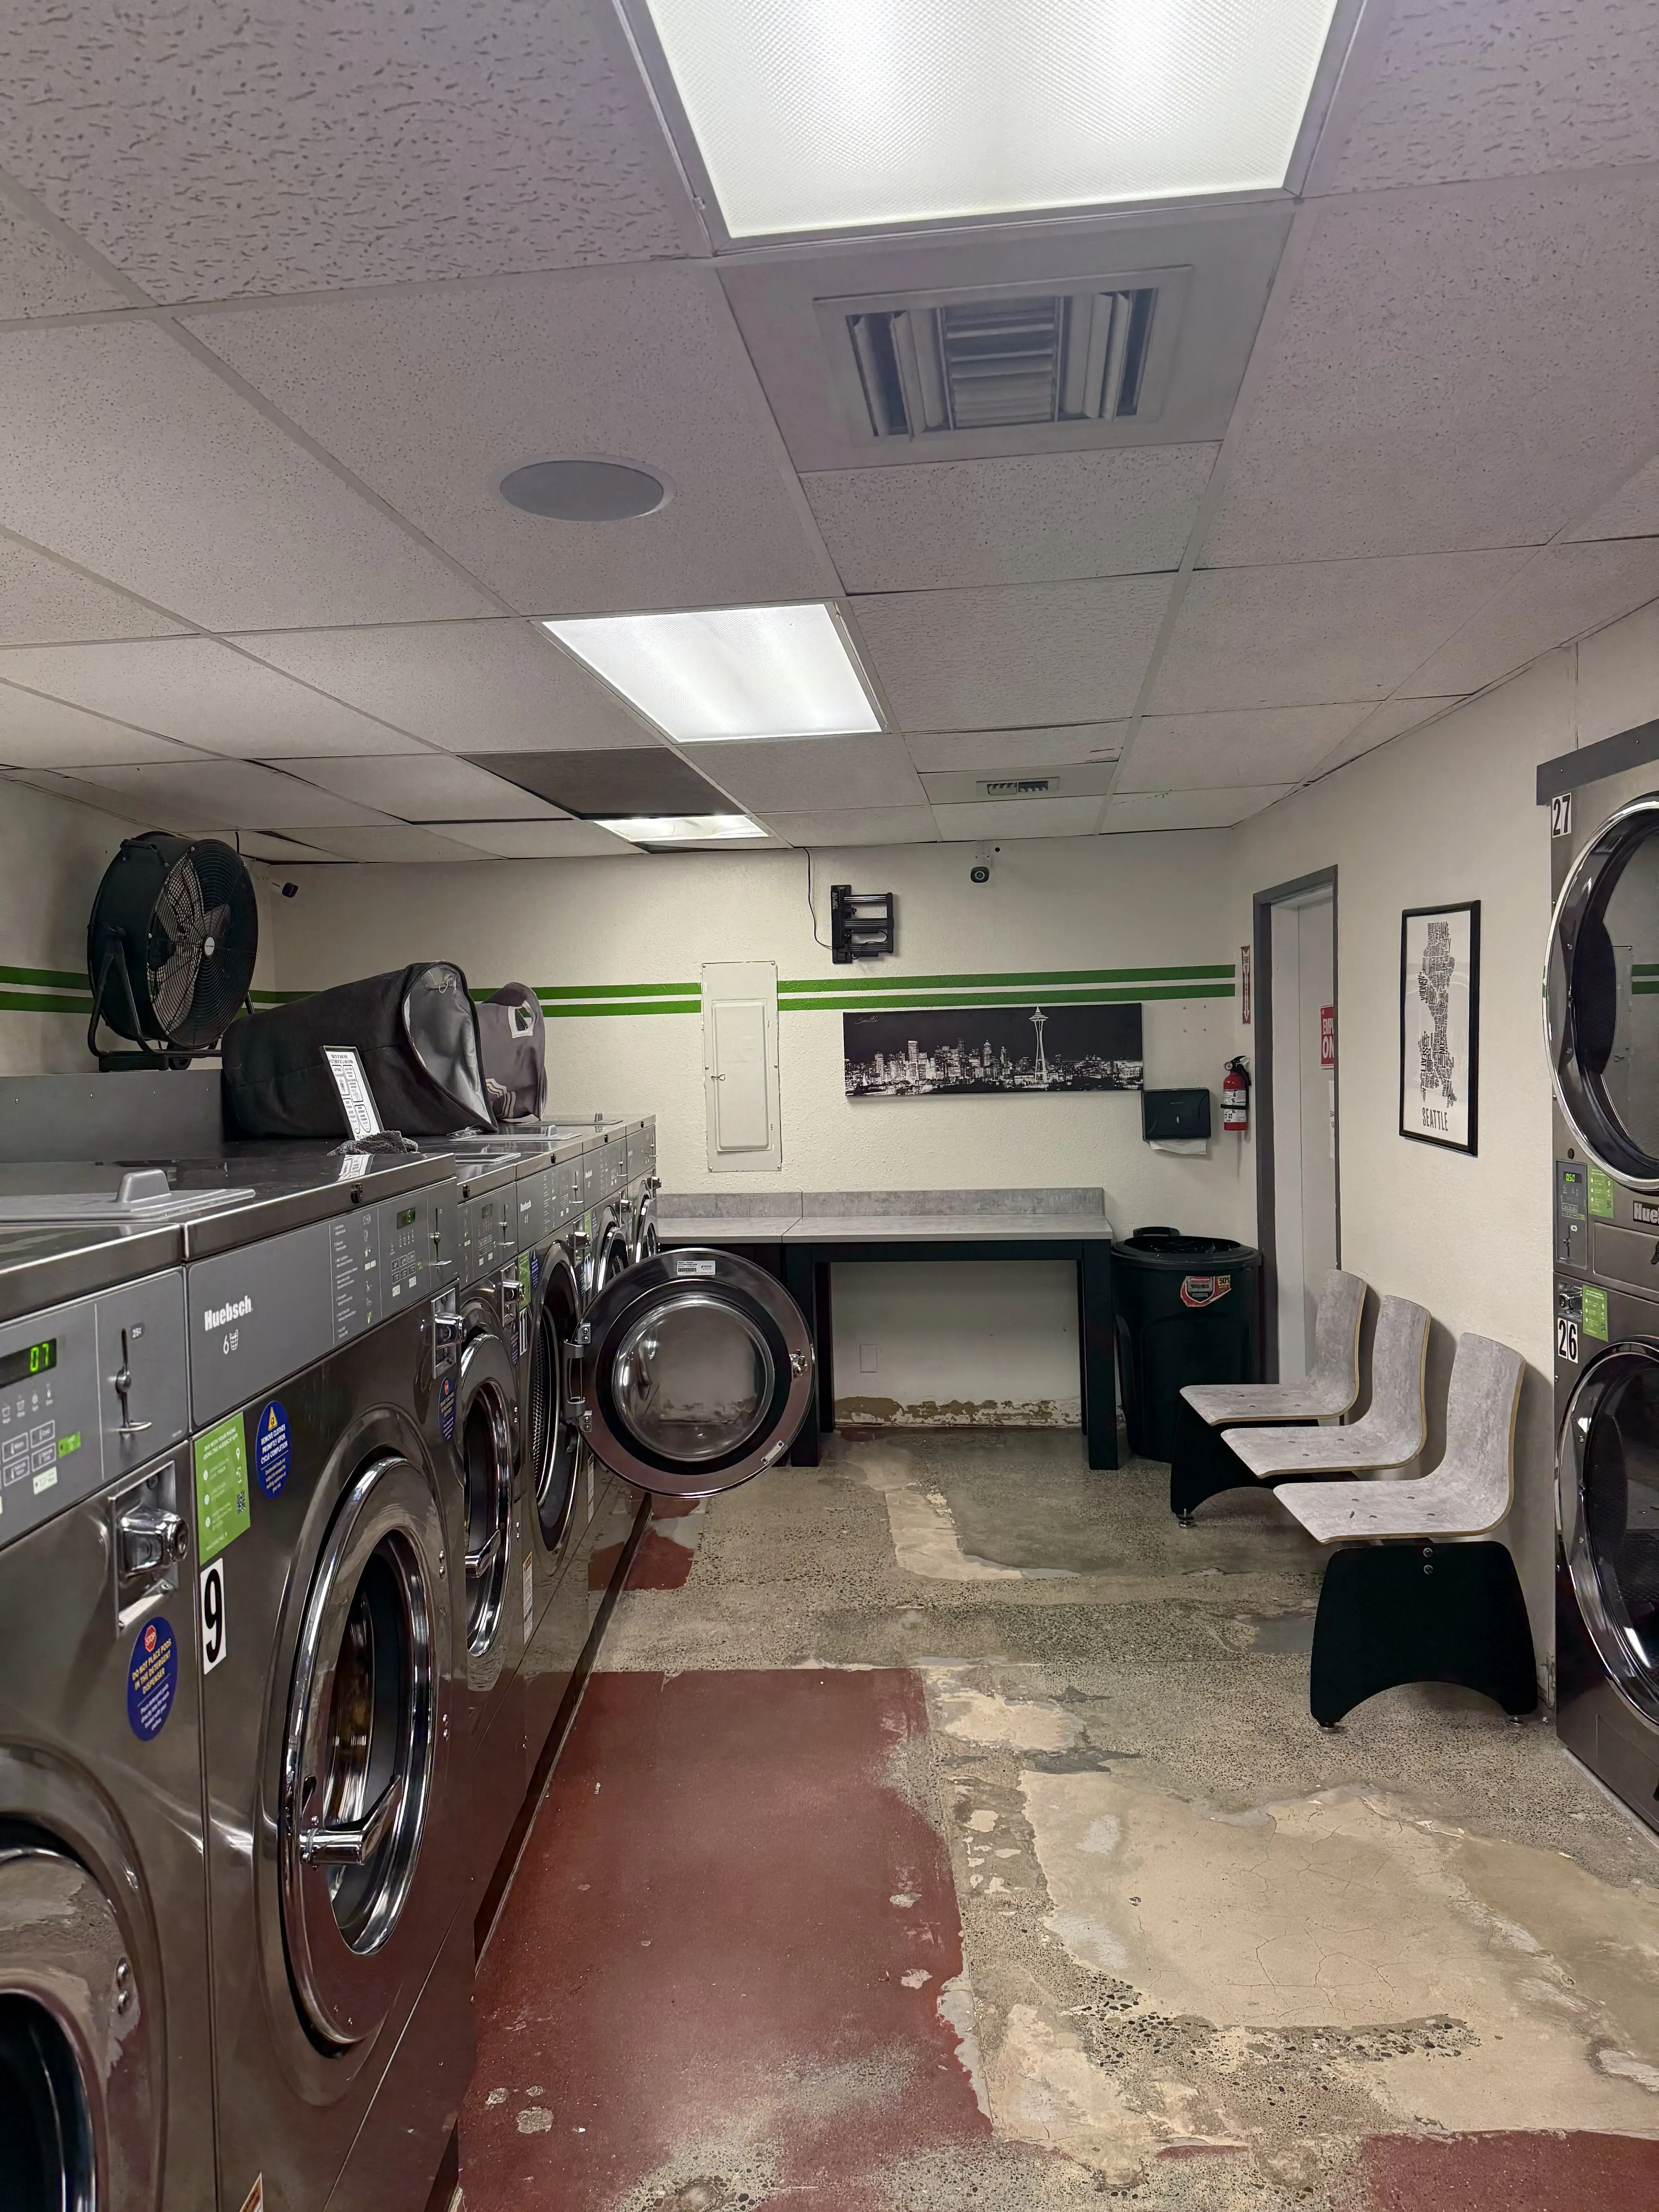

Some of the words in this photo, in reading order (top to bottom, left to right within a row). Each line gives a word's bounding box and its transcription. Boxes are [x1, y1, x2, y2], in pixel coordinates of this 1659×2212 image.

[1553, 794, 1570, 836] 27
[1422, 1108, 1448, 1131] SEATTLE
[1634, 1202, 1659, 1224] Hue
[204, 1295, 251, 1331] Huebsch
[1559, 1320, 1577, 1362] 26
[30, 1343, 49, 1372] 07
[261, 1432, 273, 1446] REMOVE
[261, 1453, 270, 1464] CYCLE
[204, 1569, 222, 1664] 9
[145, 1632, 155, 1645] STOP
[132, 1669, 139, 1681] DO
[148, 1648, 160, 1665] PLACE
[135, 1680, 140, 1691] IN
[140, 1671, 148, 1685] THE
[149, 1650, 170, 1677] DETERGENT
[143, 1668, 165, 1694] DISPENSER
